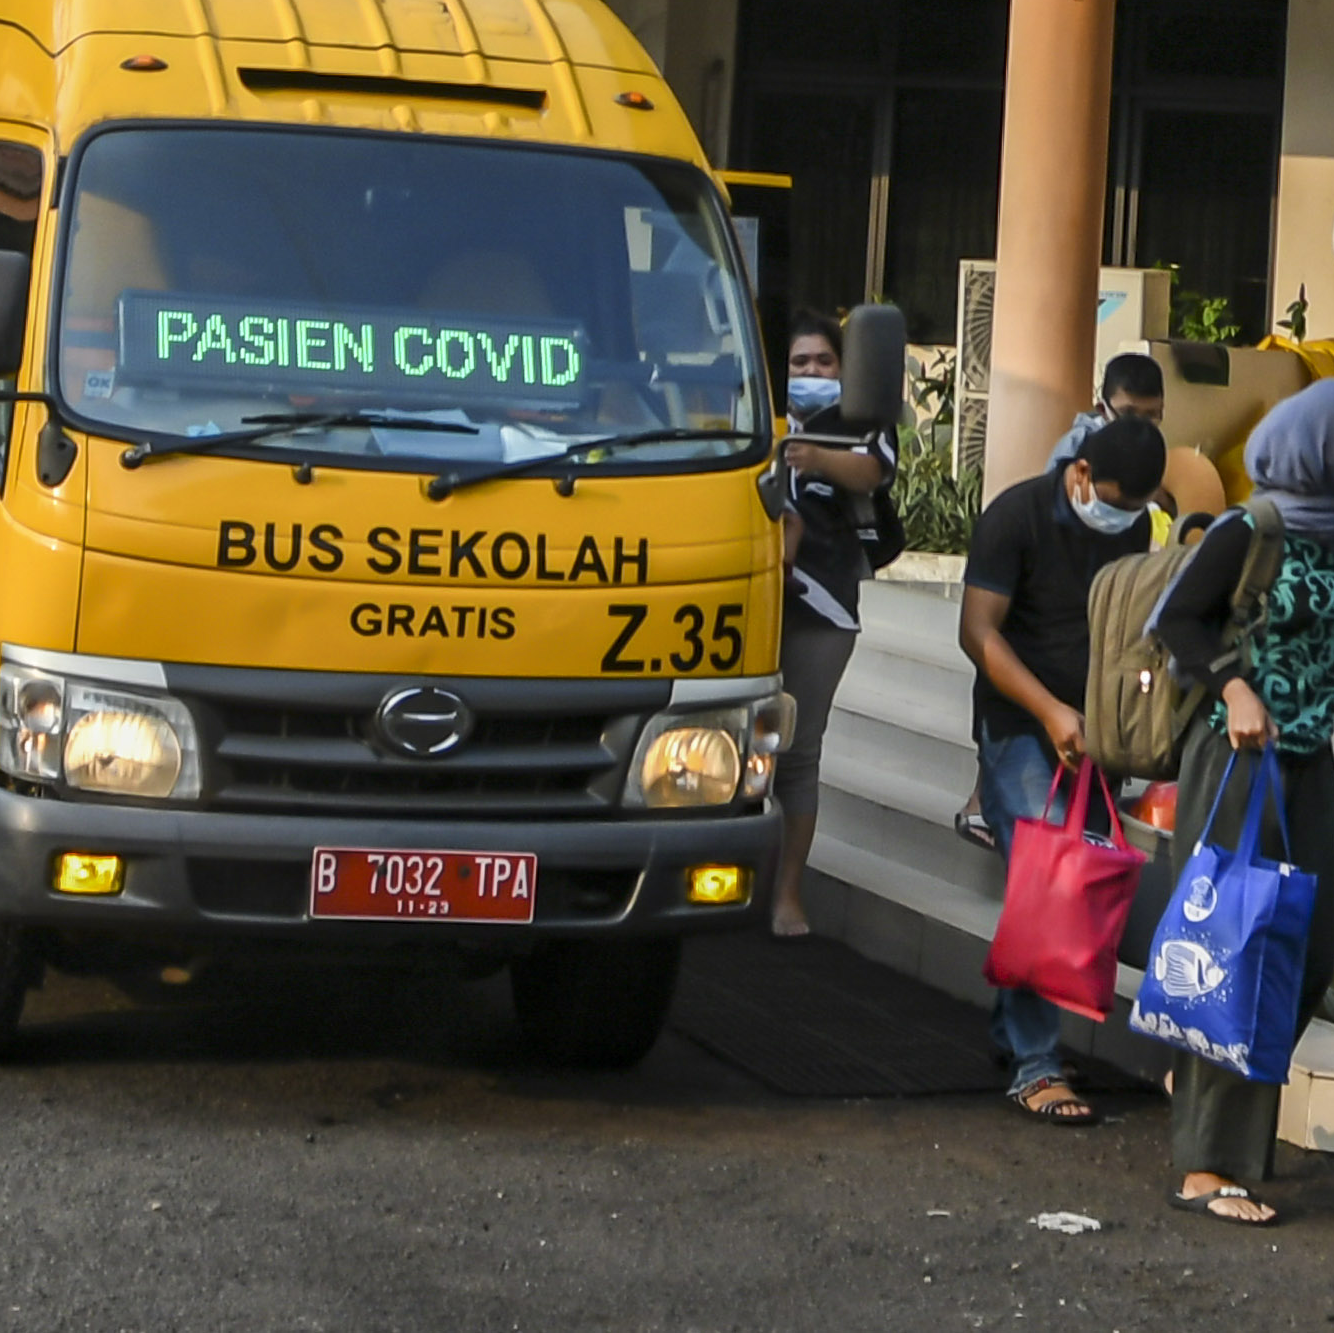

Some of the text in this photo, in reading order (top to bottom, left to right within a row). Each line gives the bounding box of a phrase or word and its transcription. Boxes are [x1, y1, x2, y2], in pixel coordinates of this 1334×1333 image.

[157, 309, 581, 387] PASIEN COVID
[217, 520, 648, 585] BUS SEKOLAH
[350, 602, 516, 640] GRATIS
[600, 603, 743, 673] Z.35
[318, 853, 529, 899] B 7032 TPA
